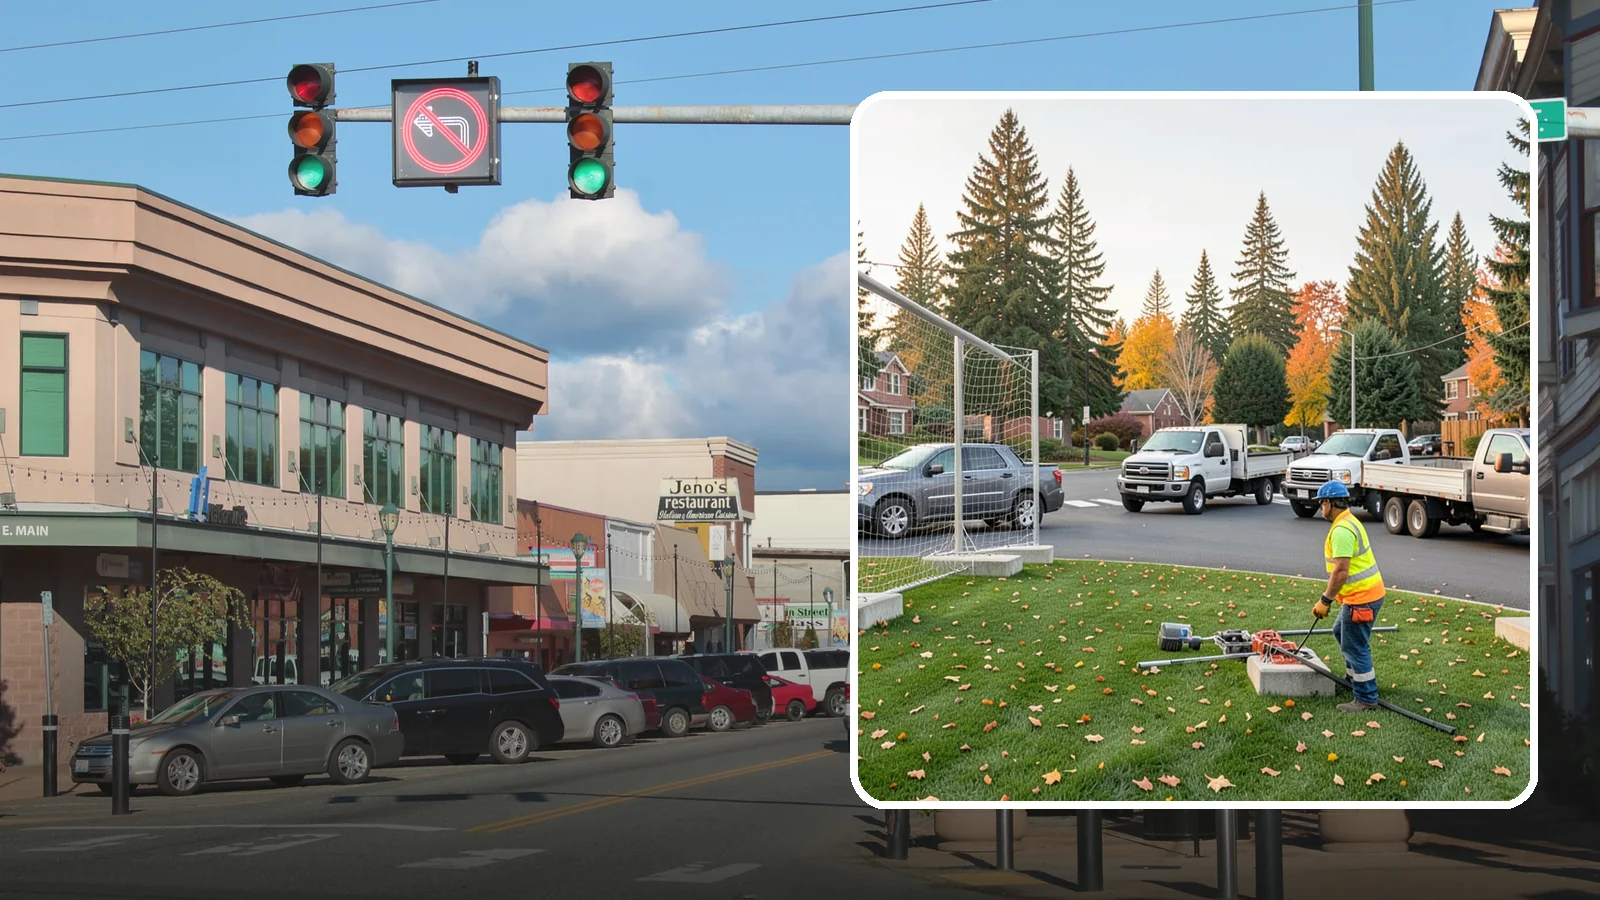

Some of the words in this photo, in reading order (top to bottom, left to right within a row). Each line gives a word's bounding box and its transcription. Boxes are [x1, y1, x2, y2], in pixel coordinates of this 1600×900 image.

[669, 480, 727, 494] Jeno's
[665, 496, 731, 509] restaurant
[658, 509, 681, 519] Italian
[685, 509, 714, 519] American
[715, 509, 738, 519] Cuisine
[2, 525, 13, 536] E.
[15, 525, 49, 536] MAIN
[797, 608, 829, 617] Street
